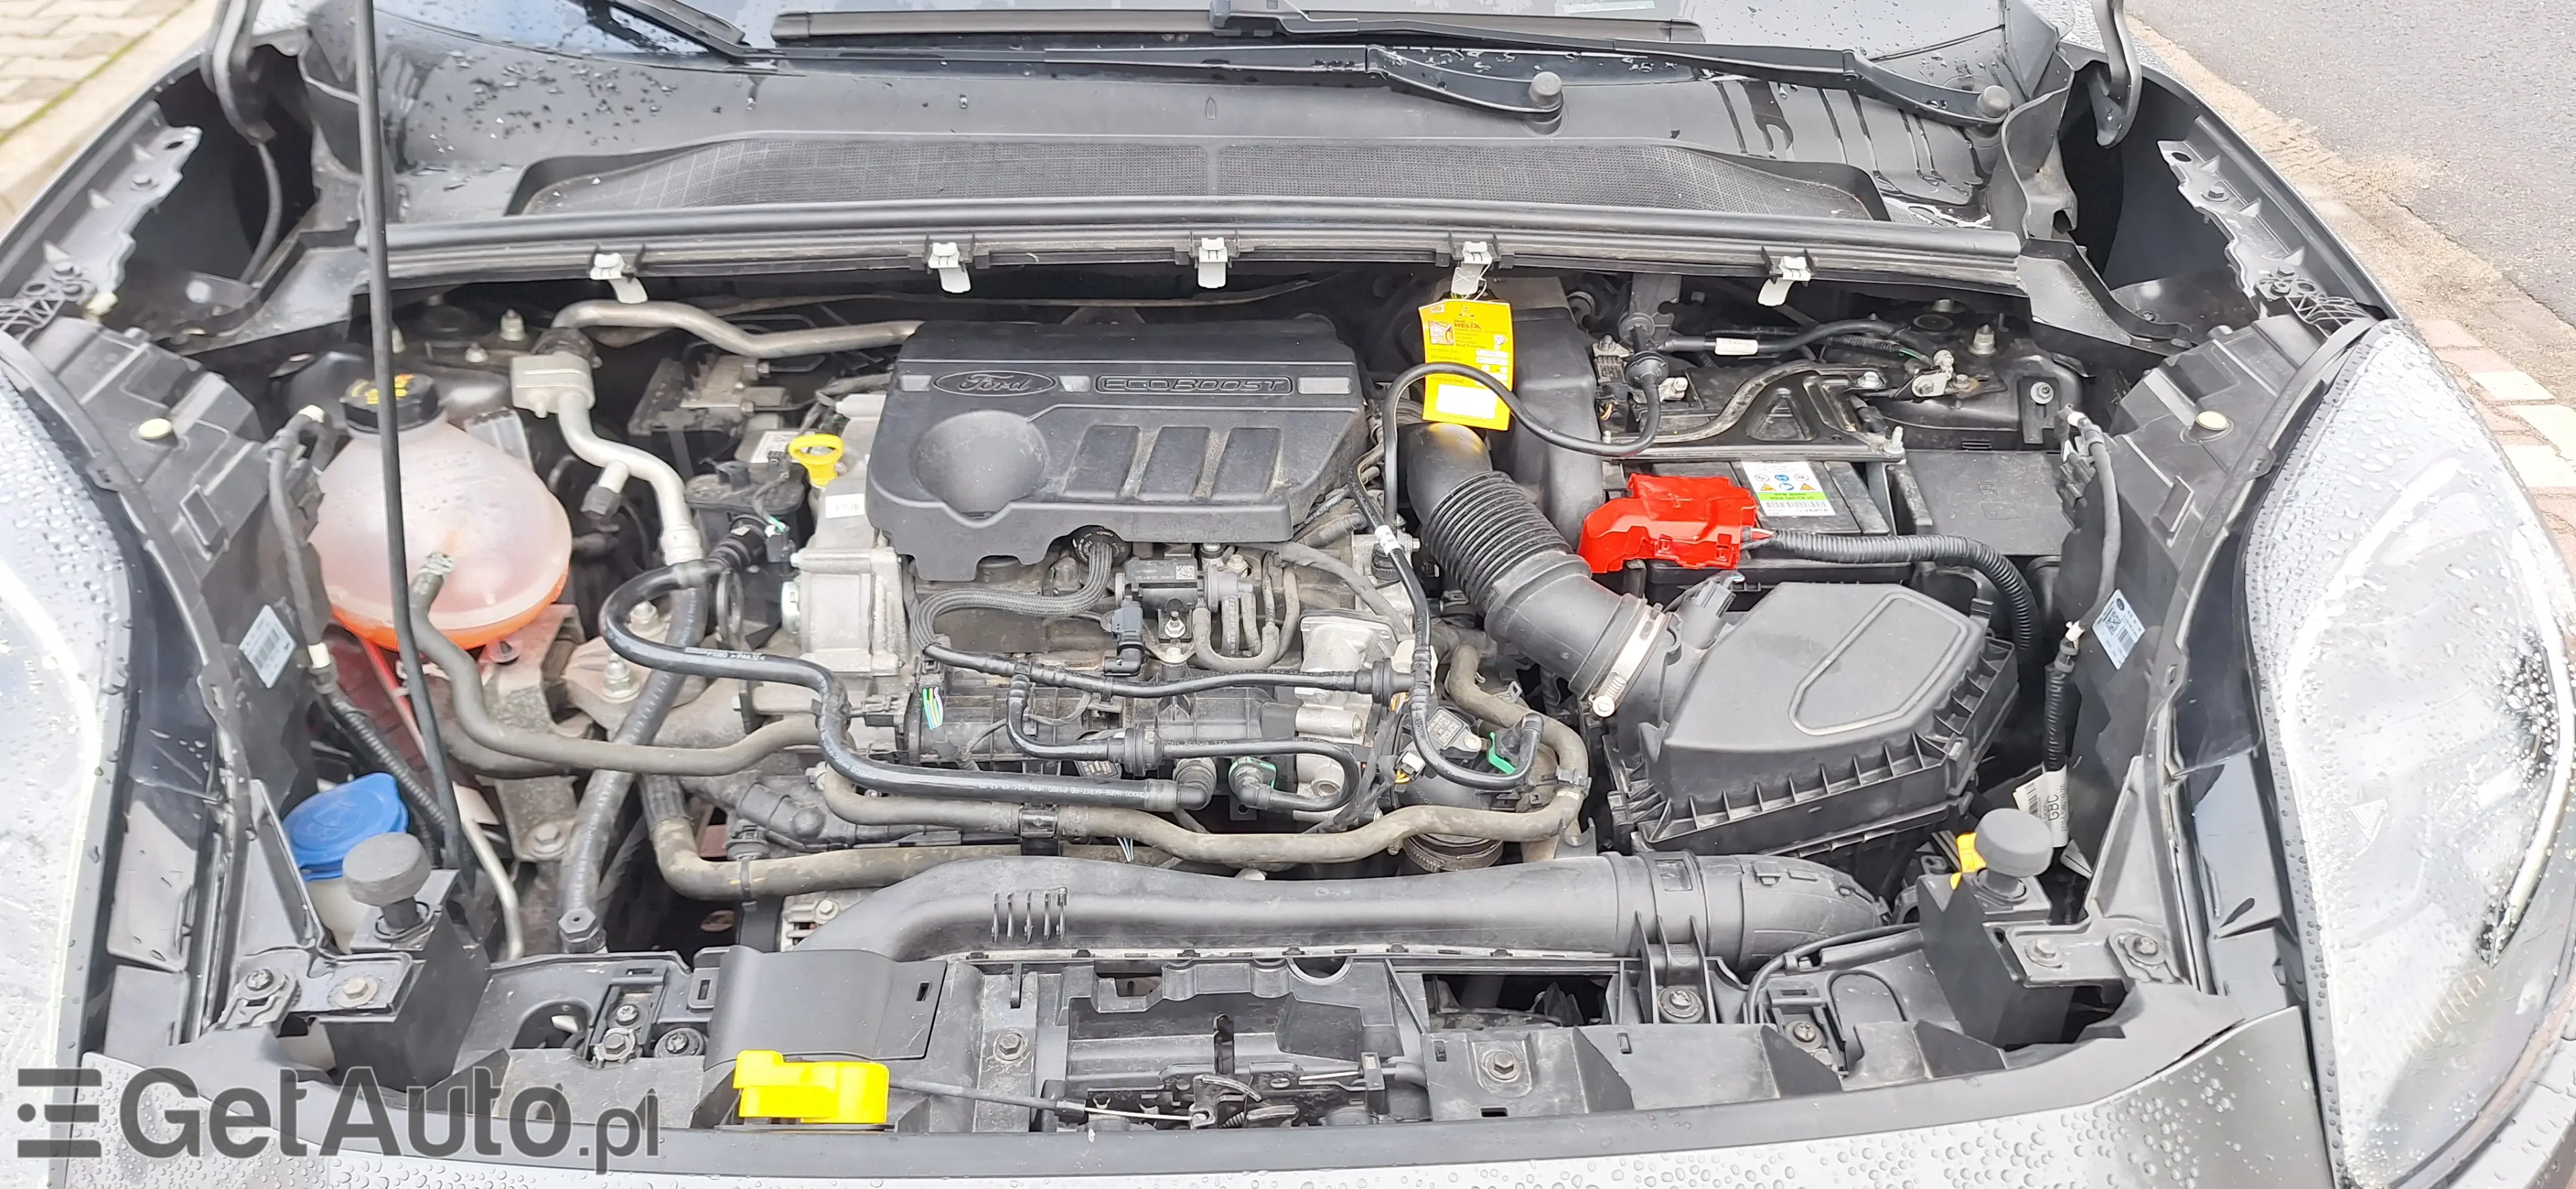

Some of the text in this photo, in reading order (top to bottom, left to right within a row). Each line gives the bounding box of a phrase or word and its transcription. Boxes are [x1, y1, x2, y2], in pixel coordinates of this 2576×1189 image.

[958, 373, 1032, 393] Ford
[1102, 378, 1287, 392] ECOBOOST
[2047, 794, 2059, 822] GBC
